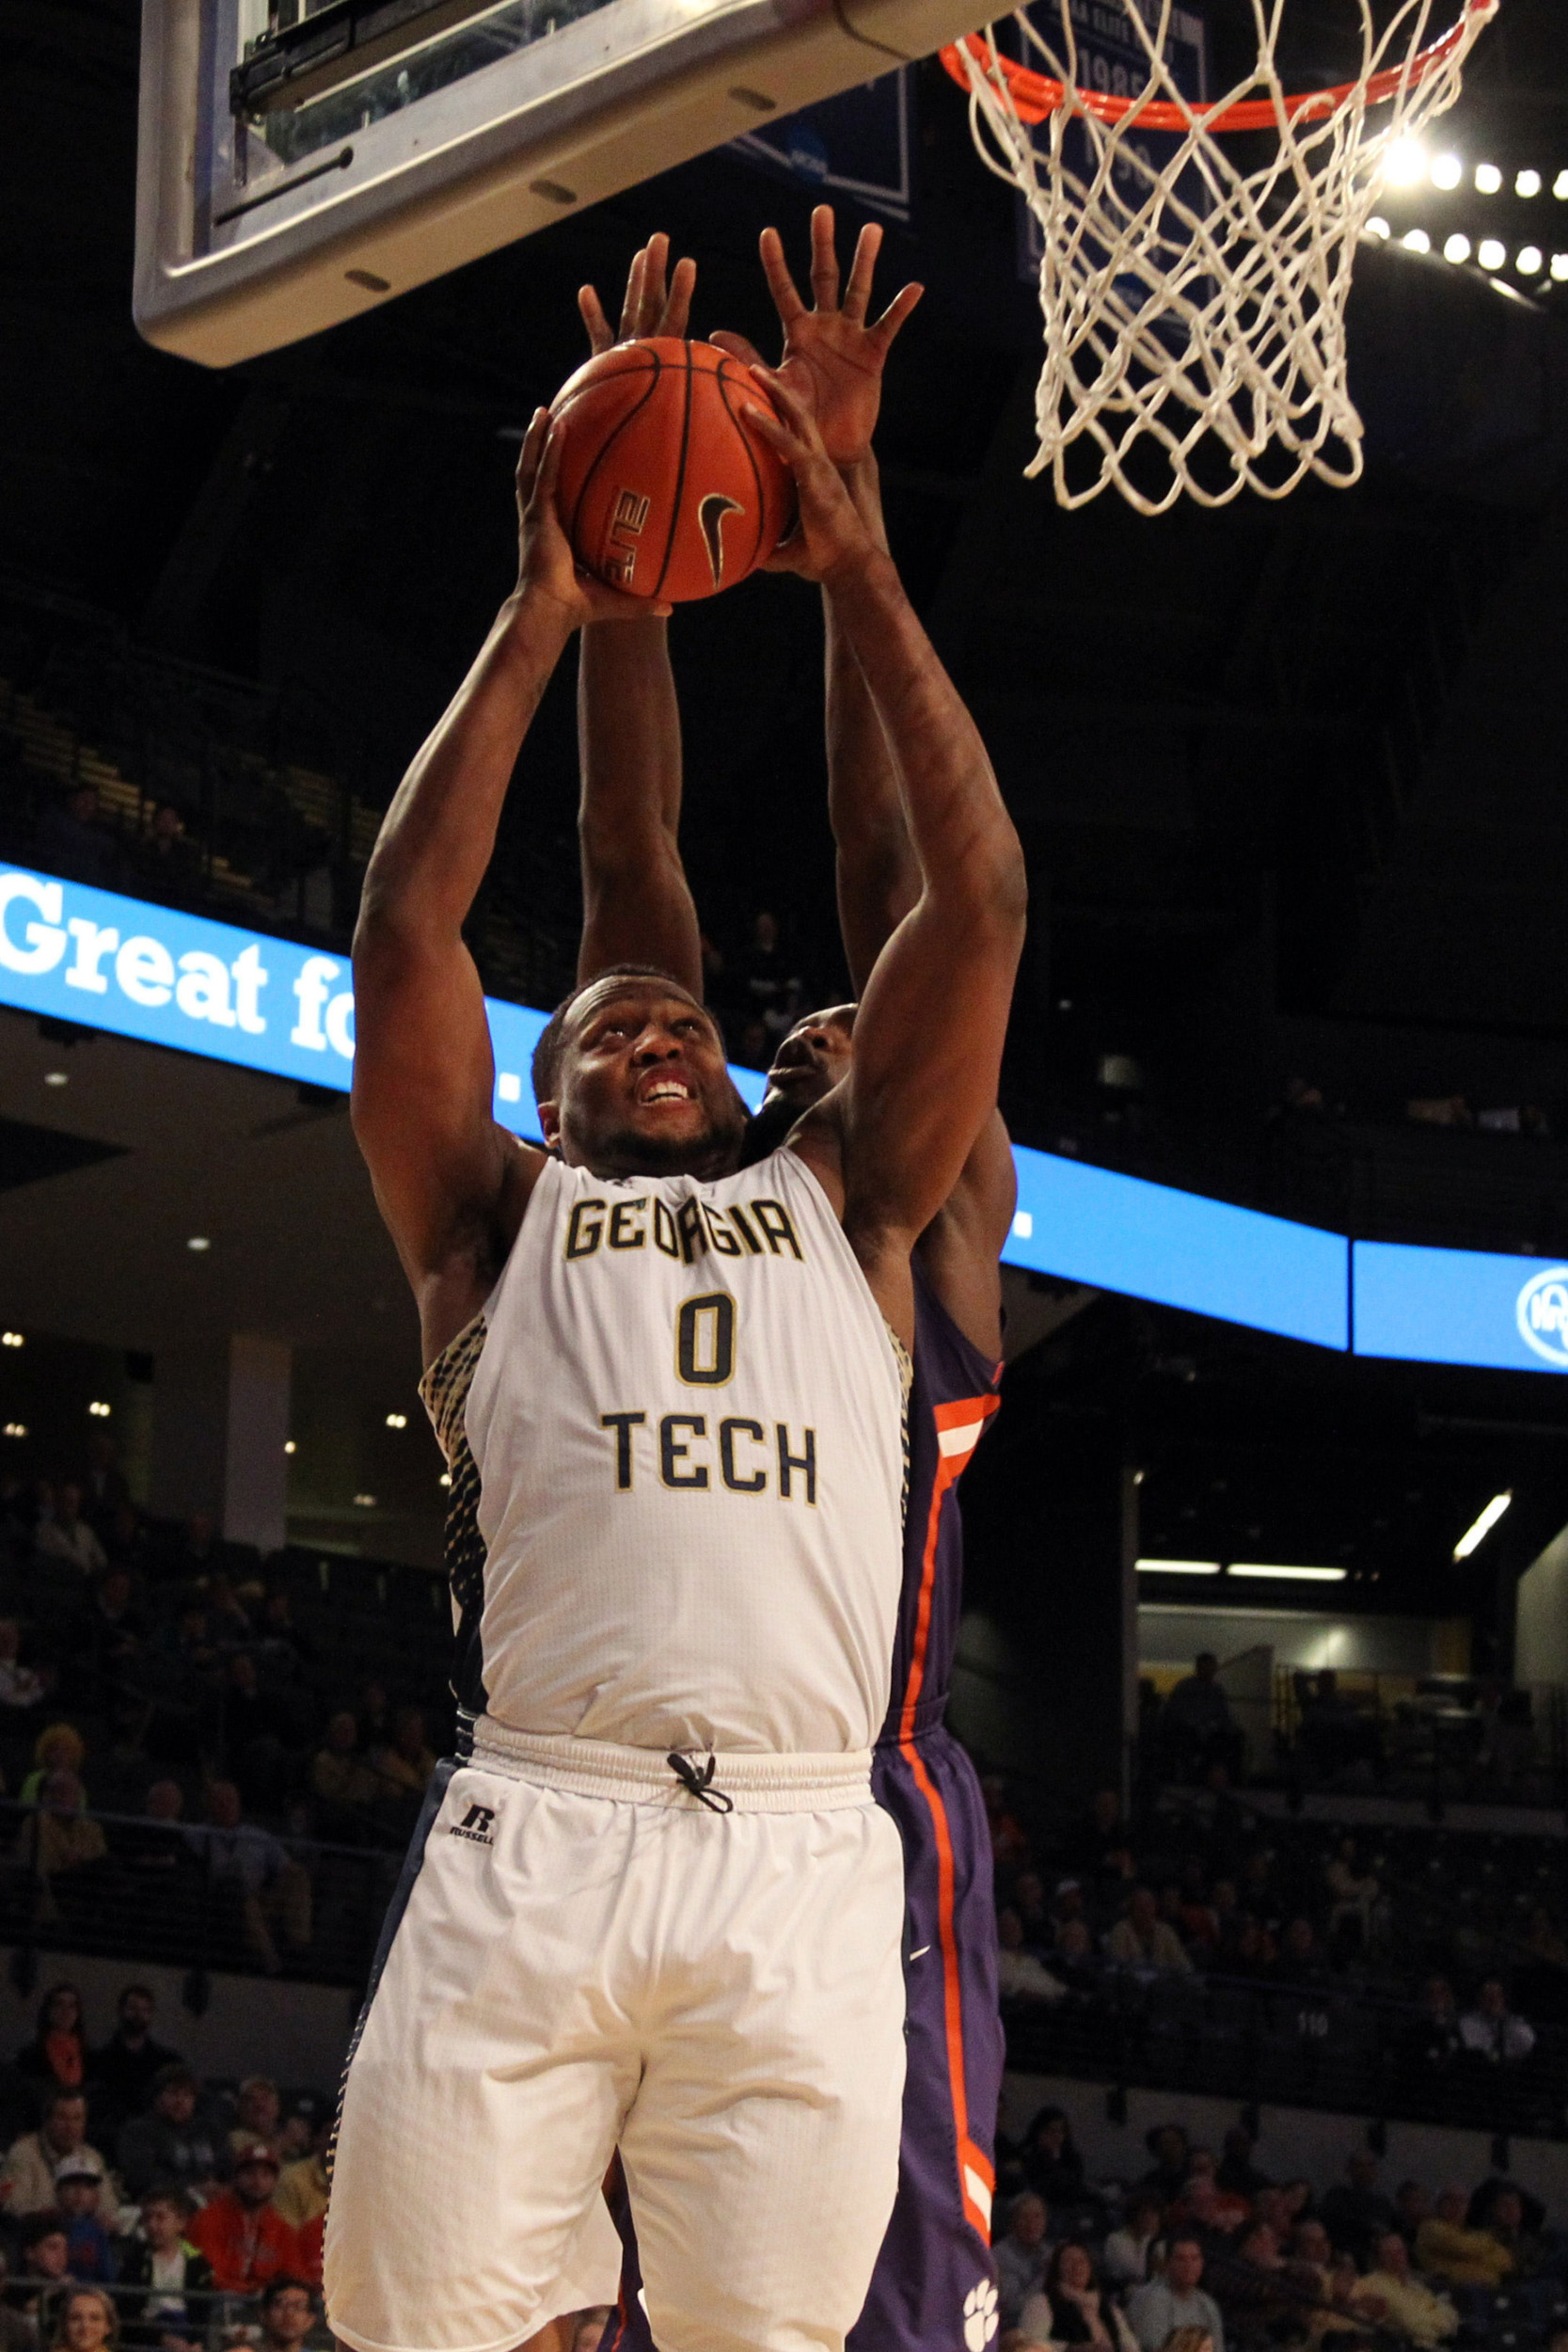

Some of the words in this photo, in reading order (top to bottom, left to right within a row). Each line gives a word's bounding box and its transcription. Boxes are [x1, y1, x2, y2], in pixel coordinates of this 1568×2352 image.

[0, 872, 268, 1035] Great
[564, 1195, 806, 1266] GEORGIA
[673, 1290, 737, 1390] 0
[600, 1410, 818, 1508] TECH
[450, 1826, 494, 1846] RUSSELL
